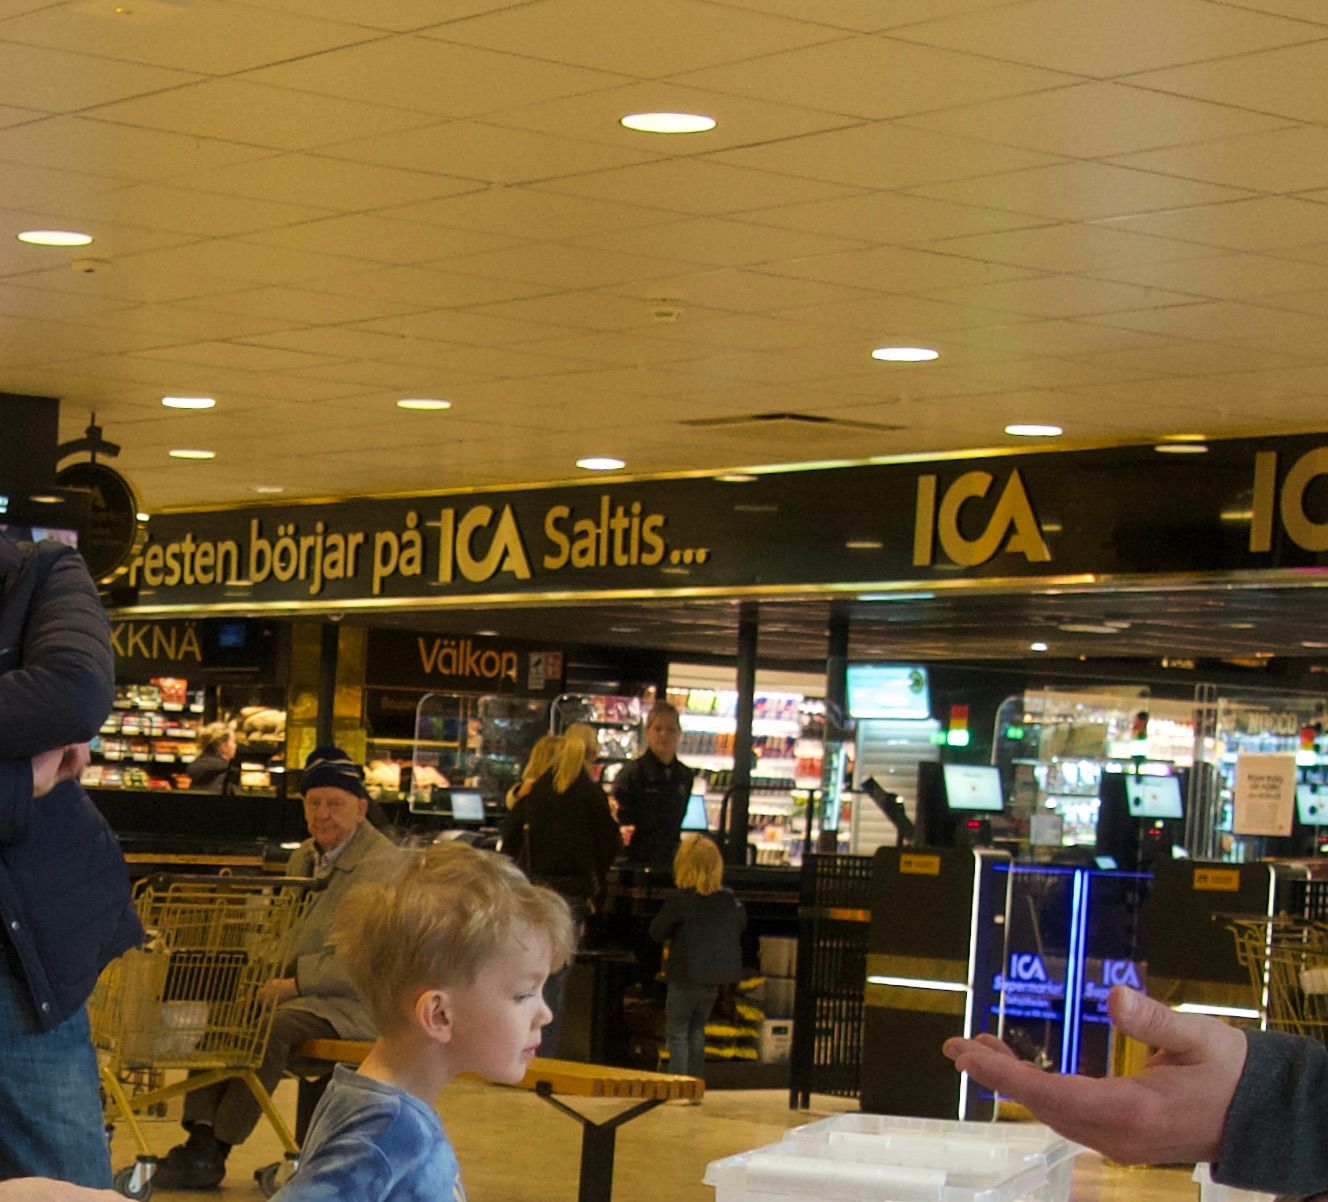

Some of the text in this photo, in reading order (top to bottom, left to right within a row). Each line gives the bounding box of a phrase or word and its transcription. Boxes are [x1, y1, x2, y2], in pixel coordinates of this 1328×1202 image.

[912, 467, 1051, 568] ICA
[250, 518, 364, 595] börjar
[372, 511, 422, 595] på
[438, 503, 531, 583] ICA
[1010, 953, 1046, 982] ICA
[1103, 958, 1140, 988] ICA
